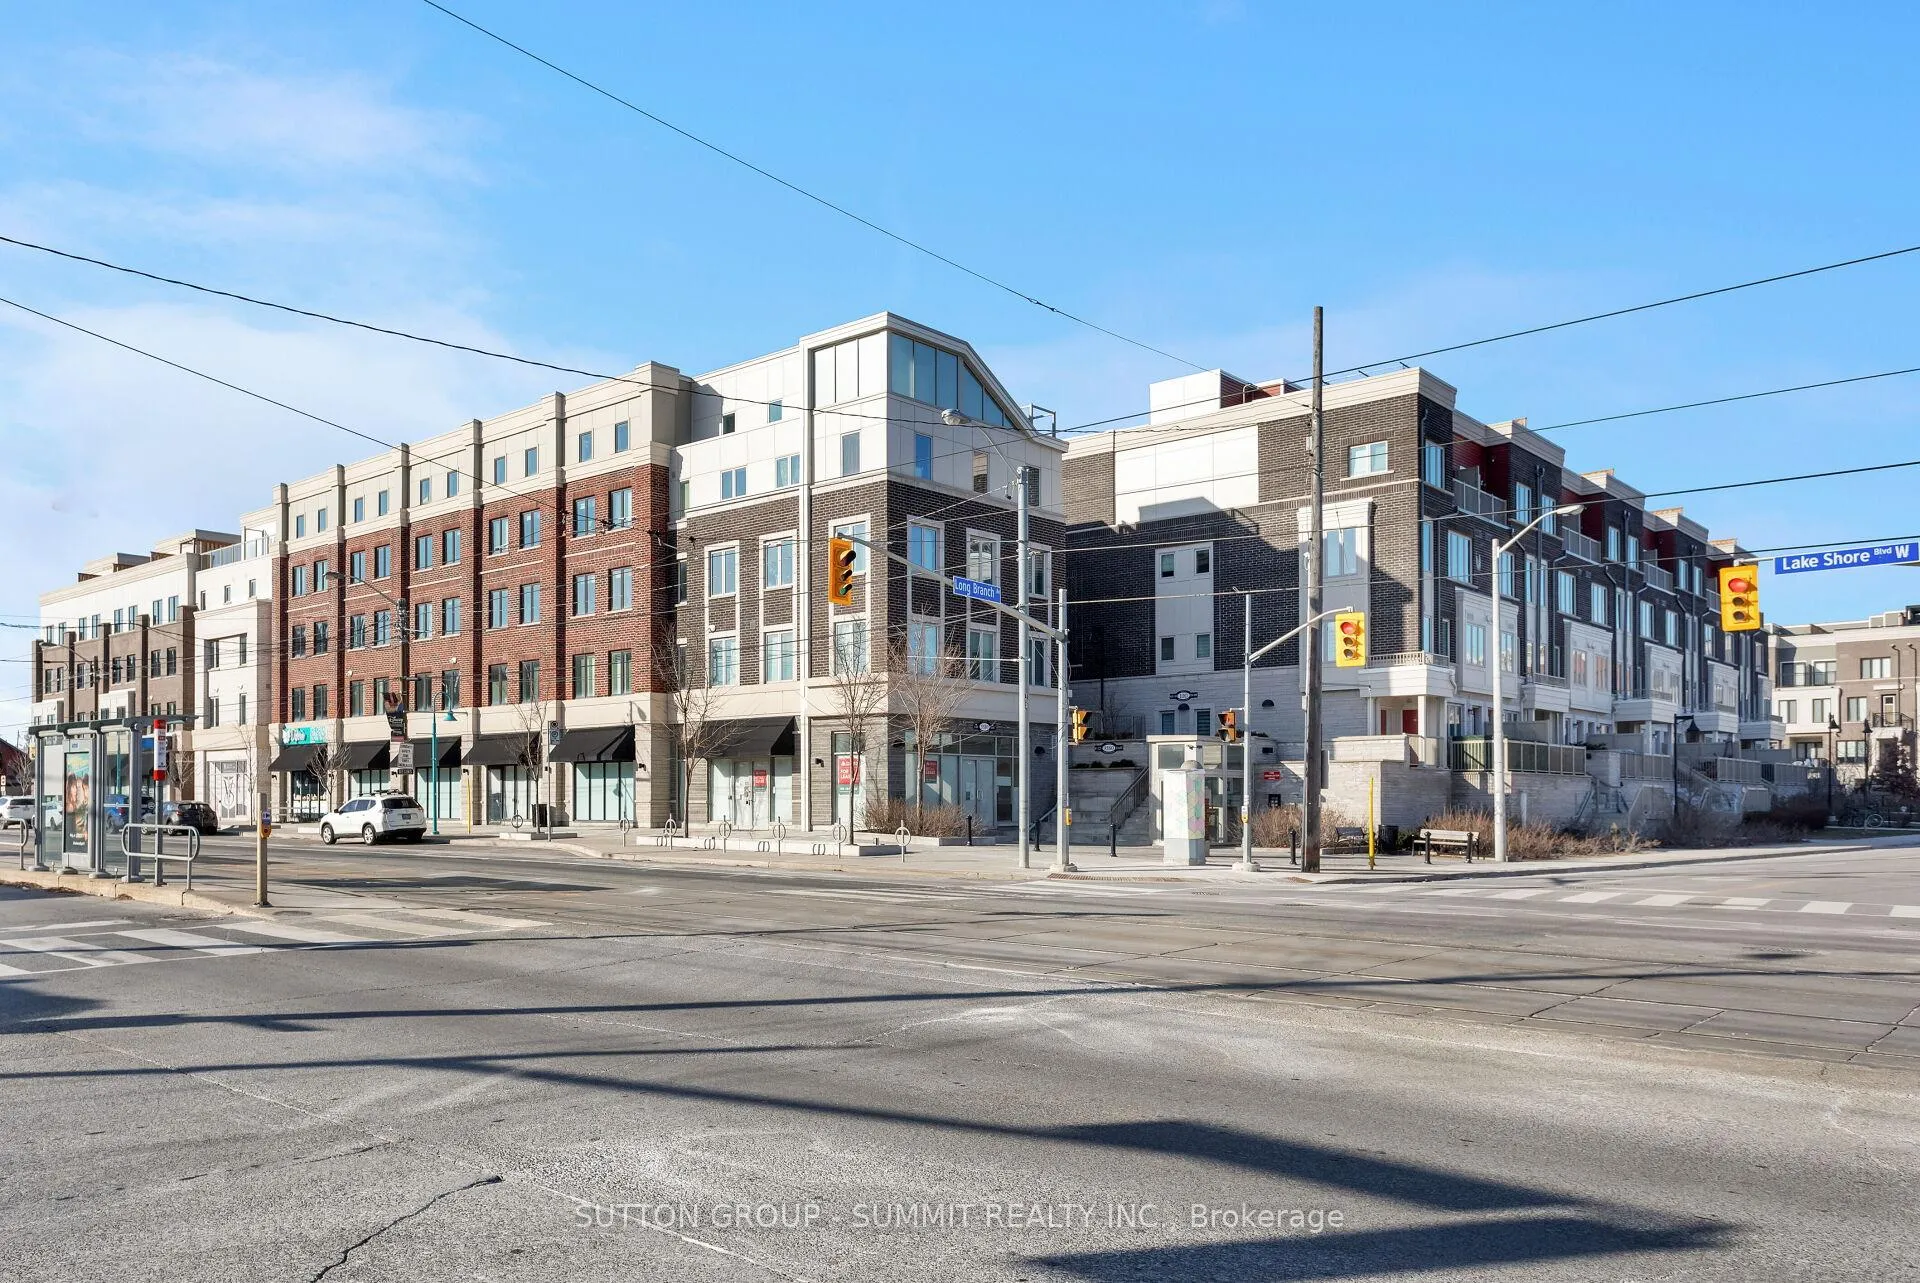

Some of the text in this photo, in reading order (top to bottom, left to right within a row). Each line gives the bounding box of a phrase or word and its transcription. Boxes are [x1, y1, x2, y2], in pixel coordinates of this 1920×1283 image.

[1782, 544, 1910, 571] Lake Shore Blvd W
[954, 579, 971, 596] Long
[972, 582, 995, 599] Branch
